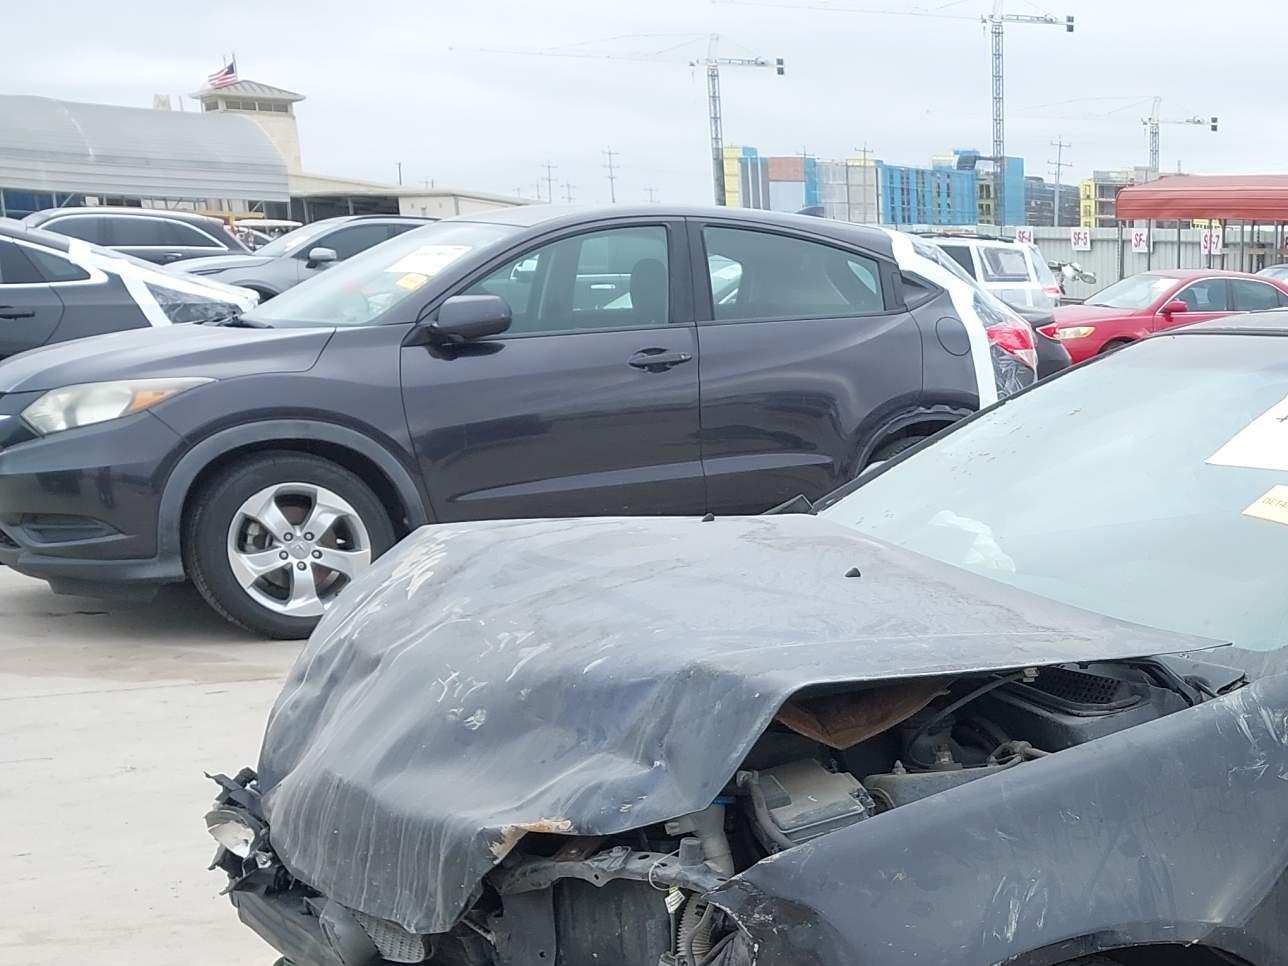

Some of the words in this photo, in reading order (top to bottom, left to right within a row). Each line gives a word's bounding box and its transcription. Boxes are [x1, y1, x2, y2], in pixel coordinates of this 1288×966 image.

[1073, 231, 1088, 246] SF-5
[1134, 232, 1150, 248] SF-
[1203, 234, 1220, 250] S-7
